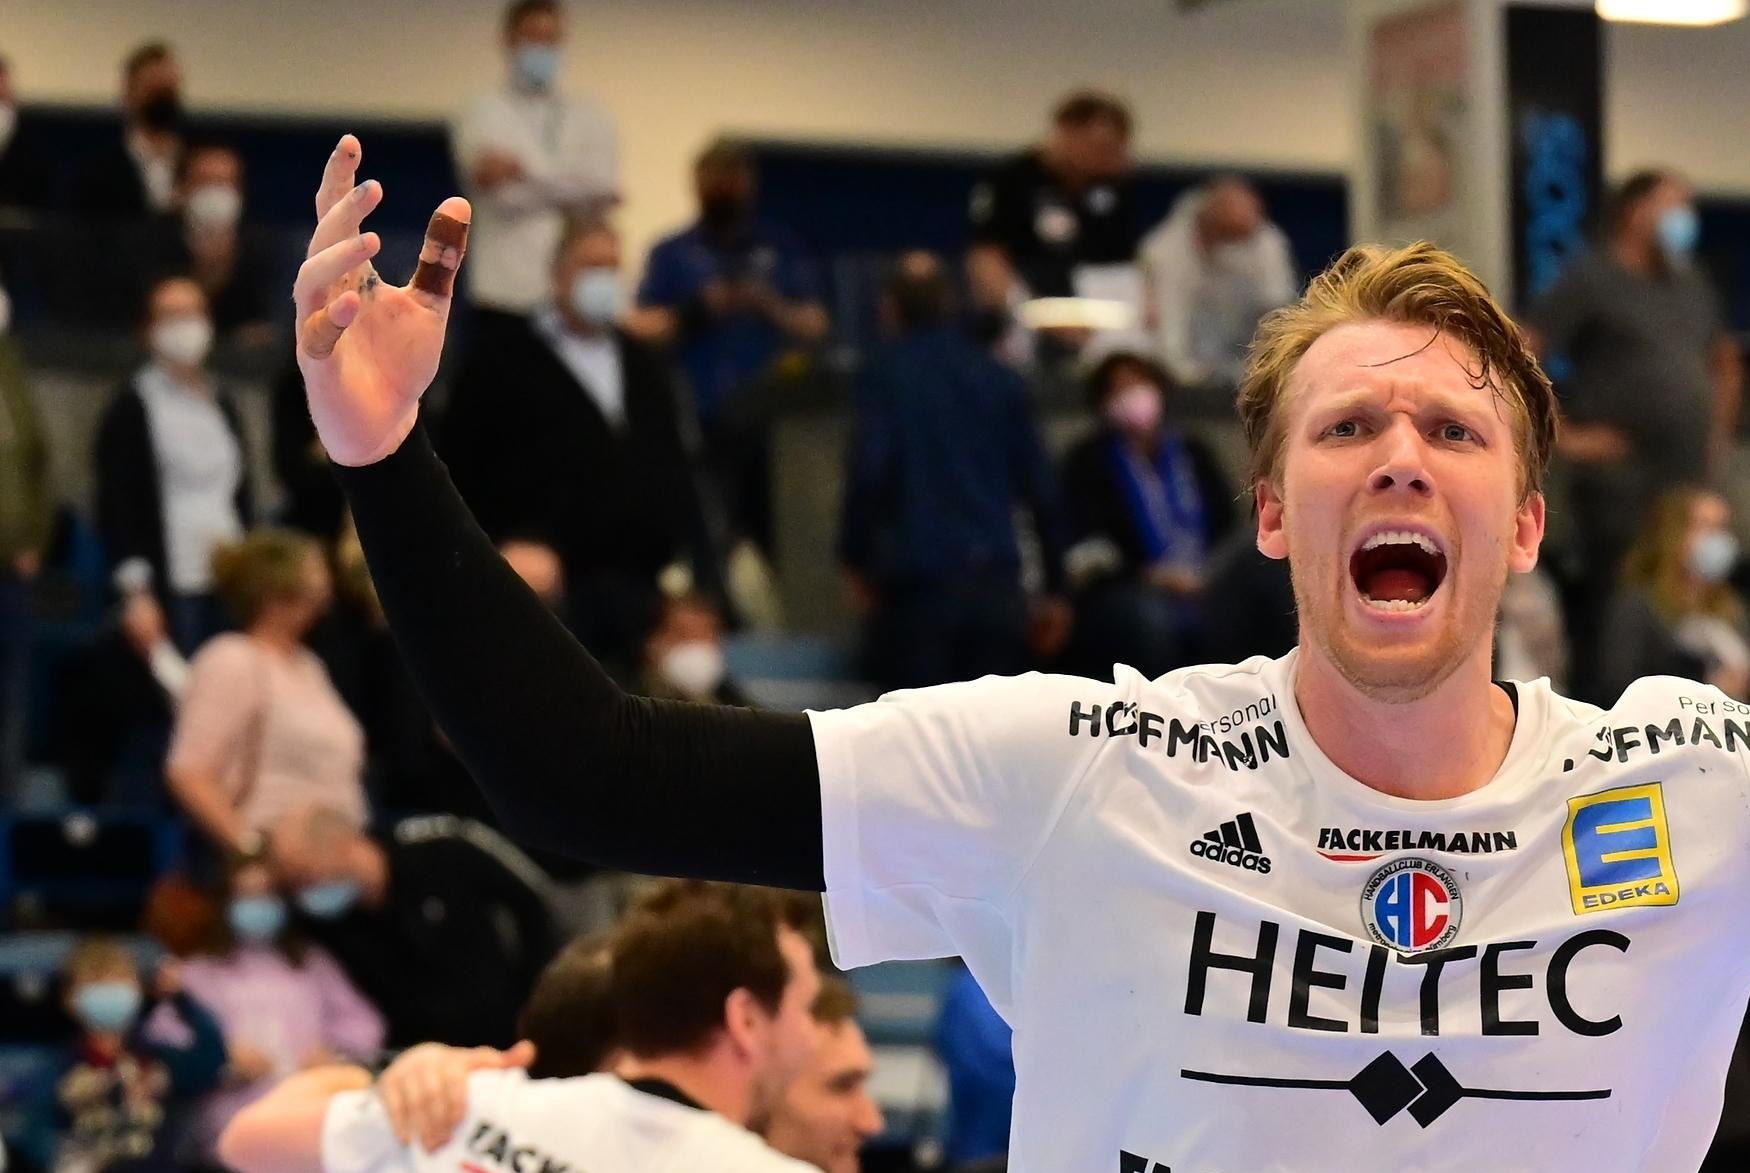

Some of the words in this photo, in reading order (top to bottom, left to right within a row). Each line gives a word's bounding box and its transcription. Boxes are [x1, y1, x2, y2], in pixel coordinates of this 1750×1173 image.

[1316, 826, 1519, 853] FACKELMANN
[1189, 838, 1272, 874] adidas
[1582, 881, 1671, 909] EDEKA
[1182, 910, 1631, 1037] HEITEC
